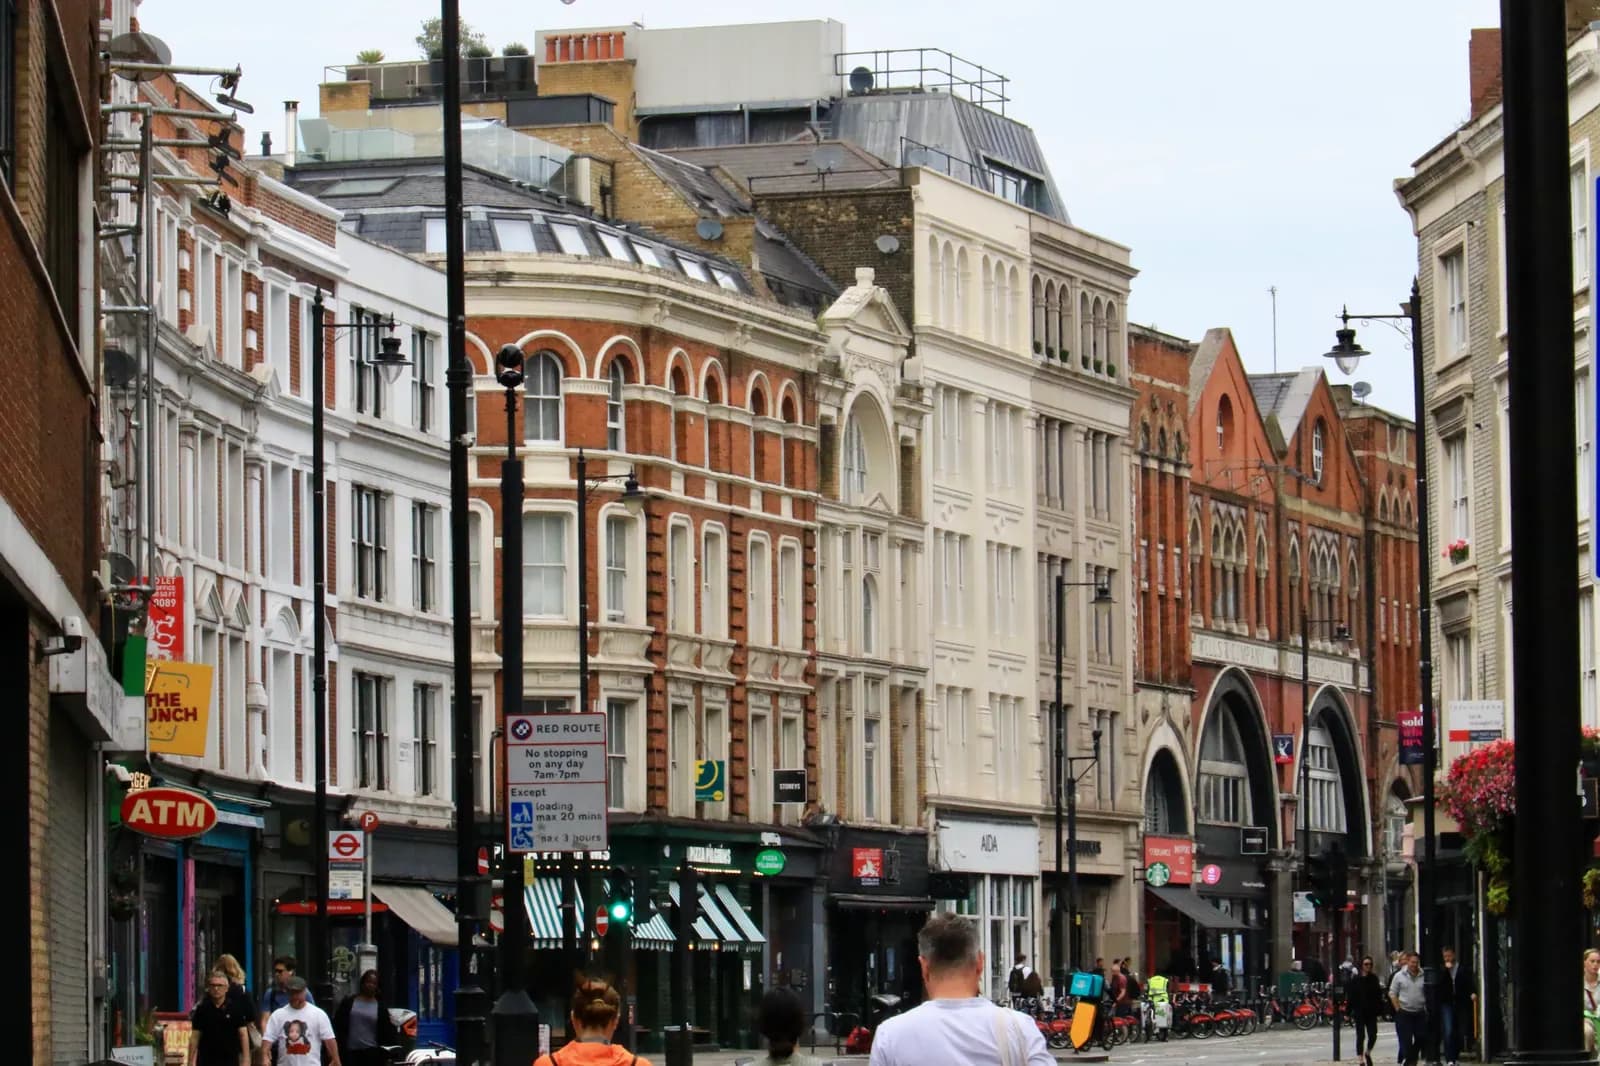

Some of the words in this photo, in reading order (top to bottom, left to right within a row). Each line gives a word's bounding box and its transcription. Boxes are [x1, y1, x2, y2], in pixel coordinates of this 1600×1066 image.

[161, 577, 176, 585] LET
[147, 692, 180, 708] THE
[148, 707, 198, 723] UNCH
[1402, 716, 1424, 727] sold
[536, 724, 560, 734] RED
[563, 723, 601, 733] ROUTE
[525, 749, 540, 758] No
[543, 749, 588, 760] stopping
[545, 761, 563, 770] any
[566, 760, 584, 769] day
[534, 769, 580, 780] 7am-7pm
[511, 788, 547, 798] Except
[536, 802, 574, 812] loading
[128, 798, 205, 828] ATM
[560, 812, 575, 821] 20
[578, 812, 602, 821] mins
[364, 814, 375, 827] P
[562, 833, 569, 842] 3
[573, 833, 601, 842] hours
[981, 834, 998, 853] AIDA
